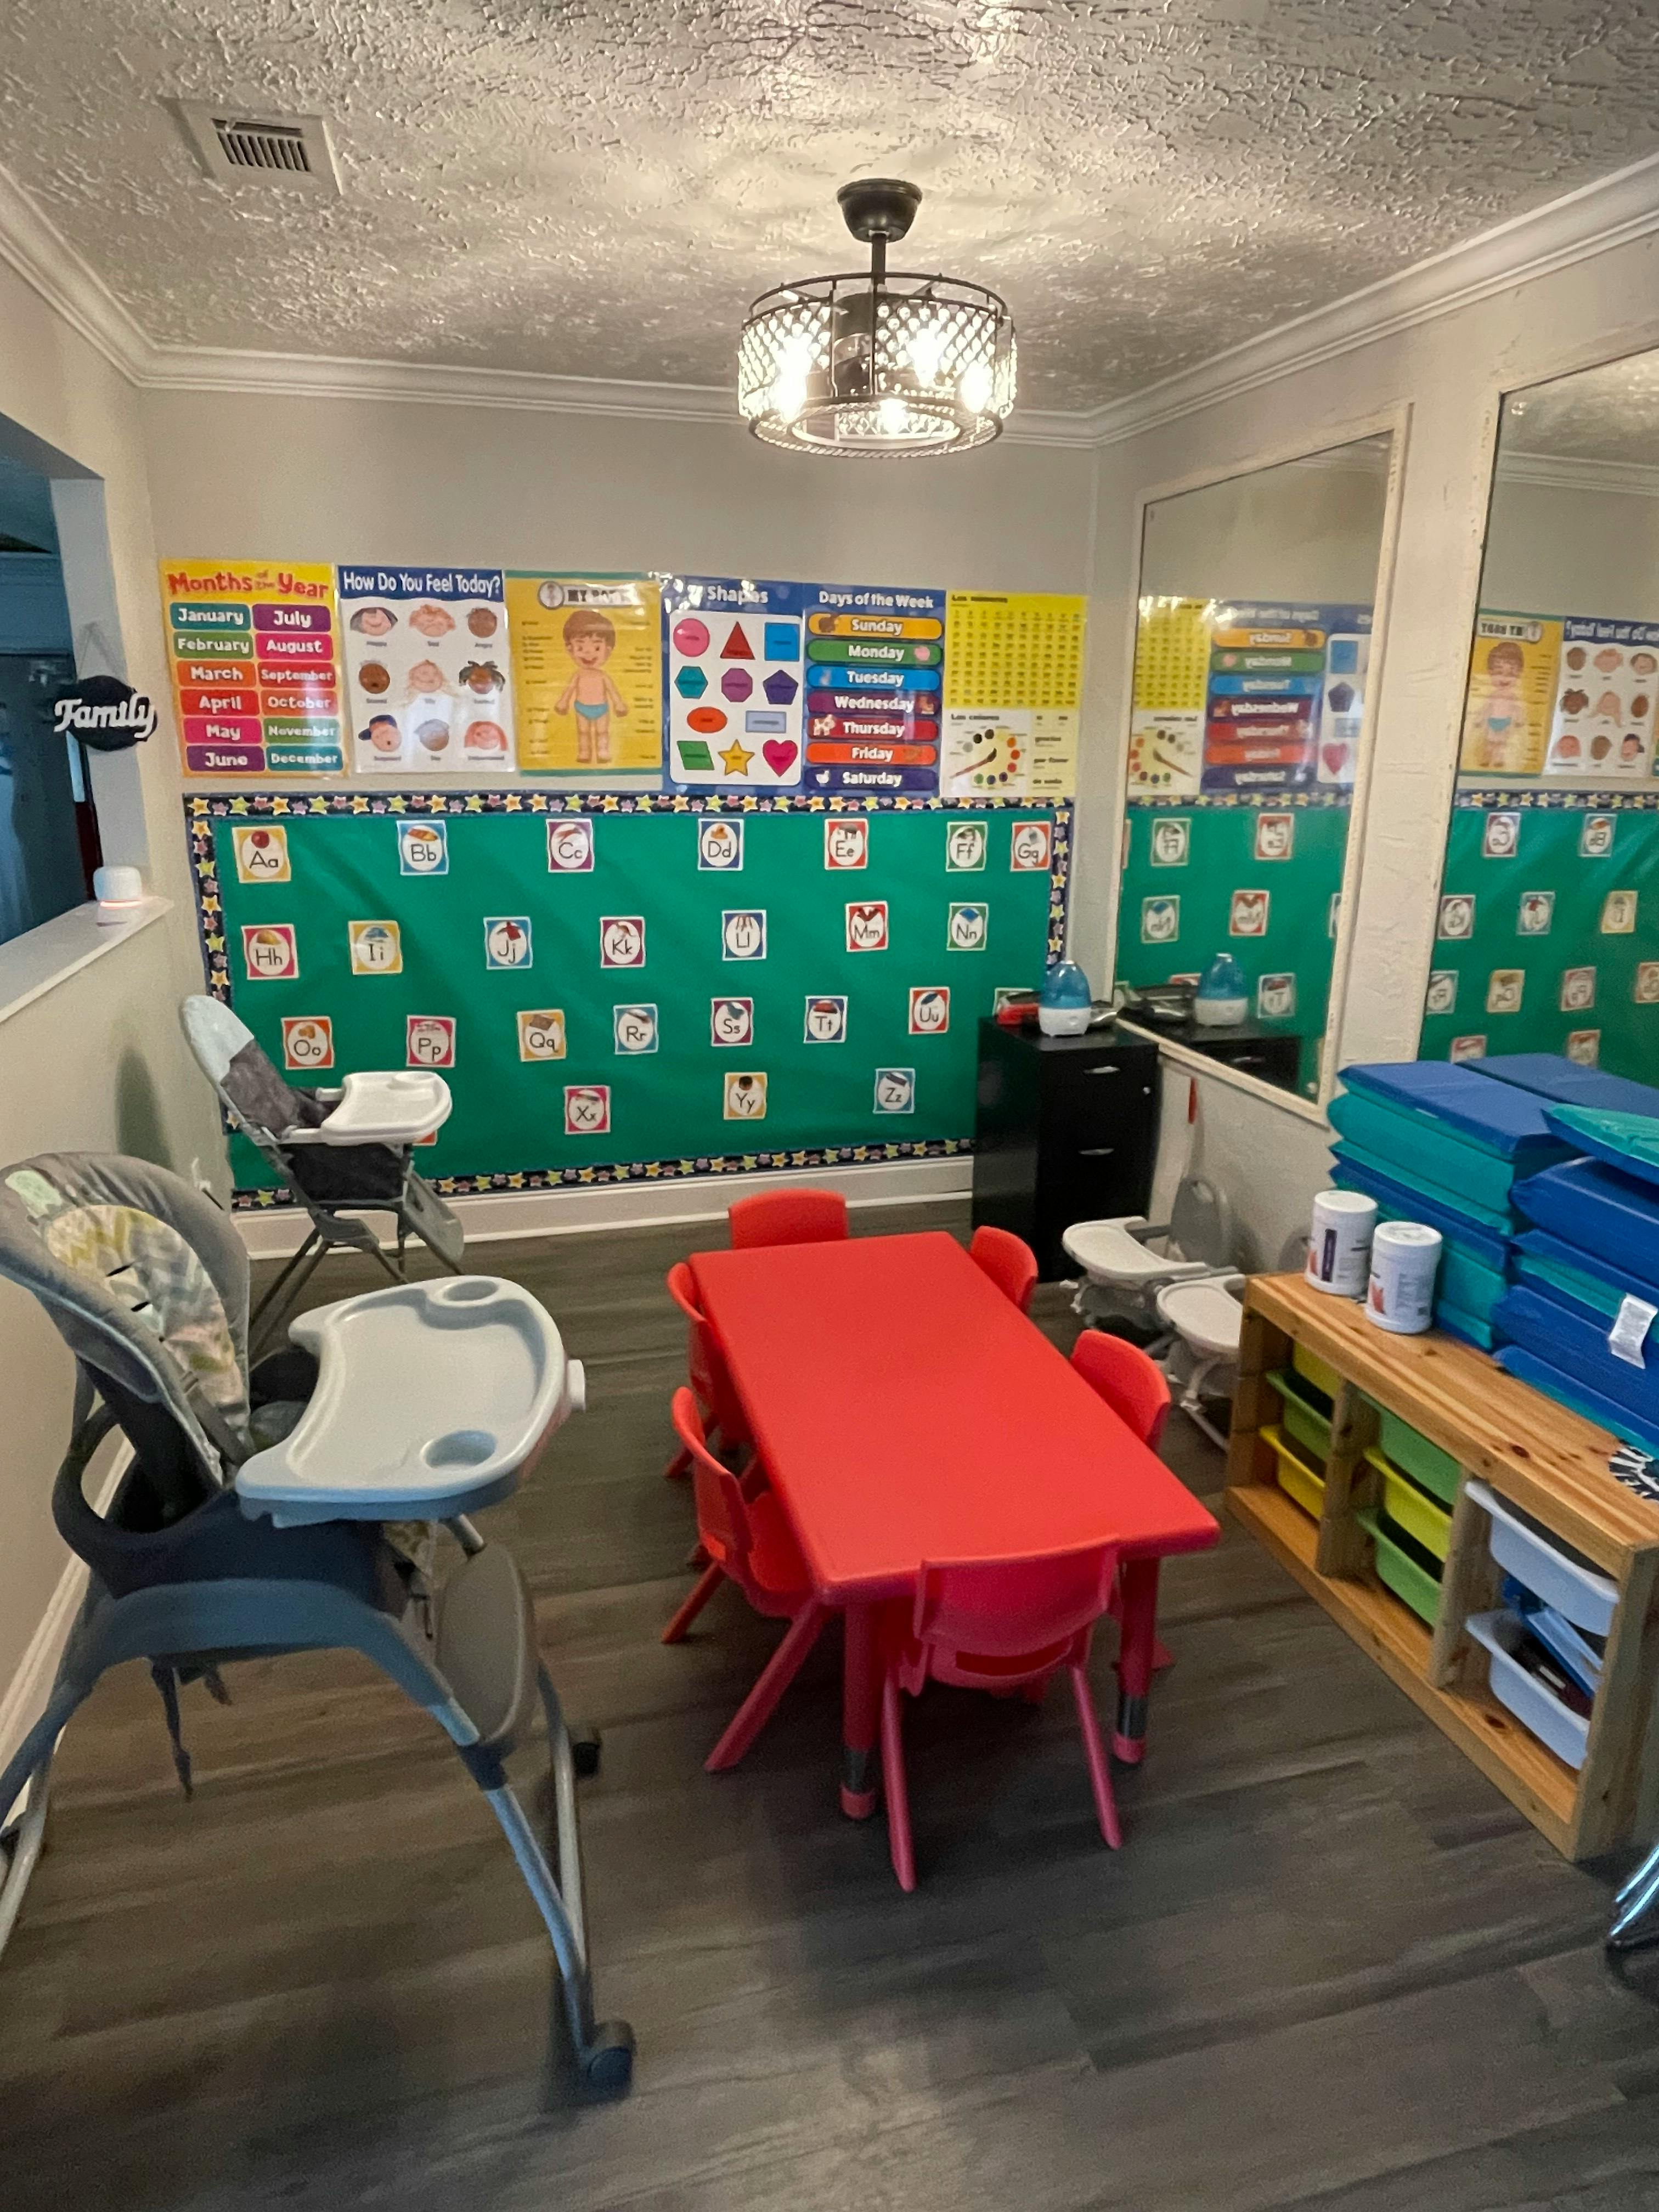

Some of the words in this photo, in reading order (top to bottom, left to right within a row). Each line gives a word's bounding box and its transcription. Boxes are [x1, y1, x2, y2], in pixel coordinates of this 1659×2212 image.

[167, 571, 253, 595] Months
[275, 572, 329, 599] Year
[343, 571, 374, 590] How
[377, 572, 397, 591] Do
[399, 573, 422, 591] You
[426, 573, 453, 593] Feel
[455, 573, 501, 598] Today?
[819, 591, 853, 607] Days
[855, 592, 870, 605] of
[871, 593, 894, 606] the
[895, 595, 934, 608] Week
[178, 608, 244, 625] January
[274, 610, 312, 628] July
[851, 619, 903, 635] Sunday
[178, 638, 250, 654] February
[266, 639, 323, 653] August
[848, 645, 905, 662] Monday
[190, 666, 244, 681] March
[261, 669, 333, 684] September
[847, 670, 904, 687] Tuesday
[199, 695, 242, 714] April
[268, 696, 331, 709] October
[834, 696, 915, 713] Wednesday
[53, 692, 155, 738] Family
[206, 724, 241, 741] May
[268, 725, 336, 737] November
[843, 721, 905, 738] Thursday
[205, 752, 249, 767] June
[271, 753, 338, 764] December
[851, 747, 894, 762] Friday
[843, 771, 902, 787] Saturday
[411, 844, 437, 862] Bb
[558, 842, 583, 859] Cc
[707, 840, 731, 857] Dd
[835, 840, 854, 857] Ee
[956, 843, 975, 859] Ff
[1018, 843, 1039, 866] Gg
[249, 850, 278, 868] Aa
[854, 924, 880, 940] Mm
[956, 924, 977, 940] Nn
[368, 943, 385, 961] Ii
[497, 940, 516, 963] Jj
[612, 939, 633, 955] Kk
[256, 947, 283, 966] Hh
[814, 1015, 833, 1032] Tt
[919, 1007, 939, 1023] Uu
[627, 1026, 647, 1042] Rr
[723, 1019, 741, 1035] Ss
[294, 1039, 321, 1057] Oo
[418, 1038, 442, 1062] Pp
[529, 1031, 559, 1053] Qq
[736, 1093, 755, 1114] Yy
[884, 1087, 902, 1103] Zz
[575, 1106, 597, 1122] Xx
